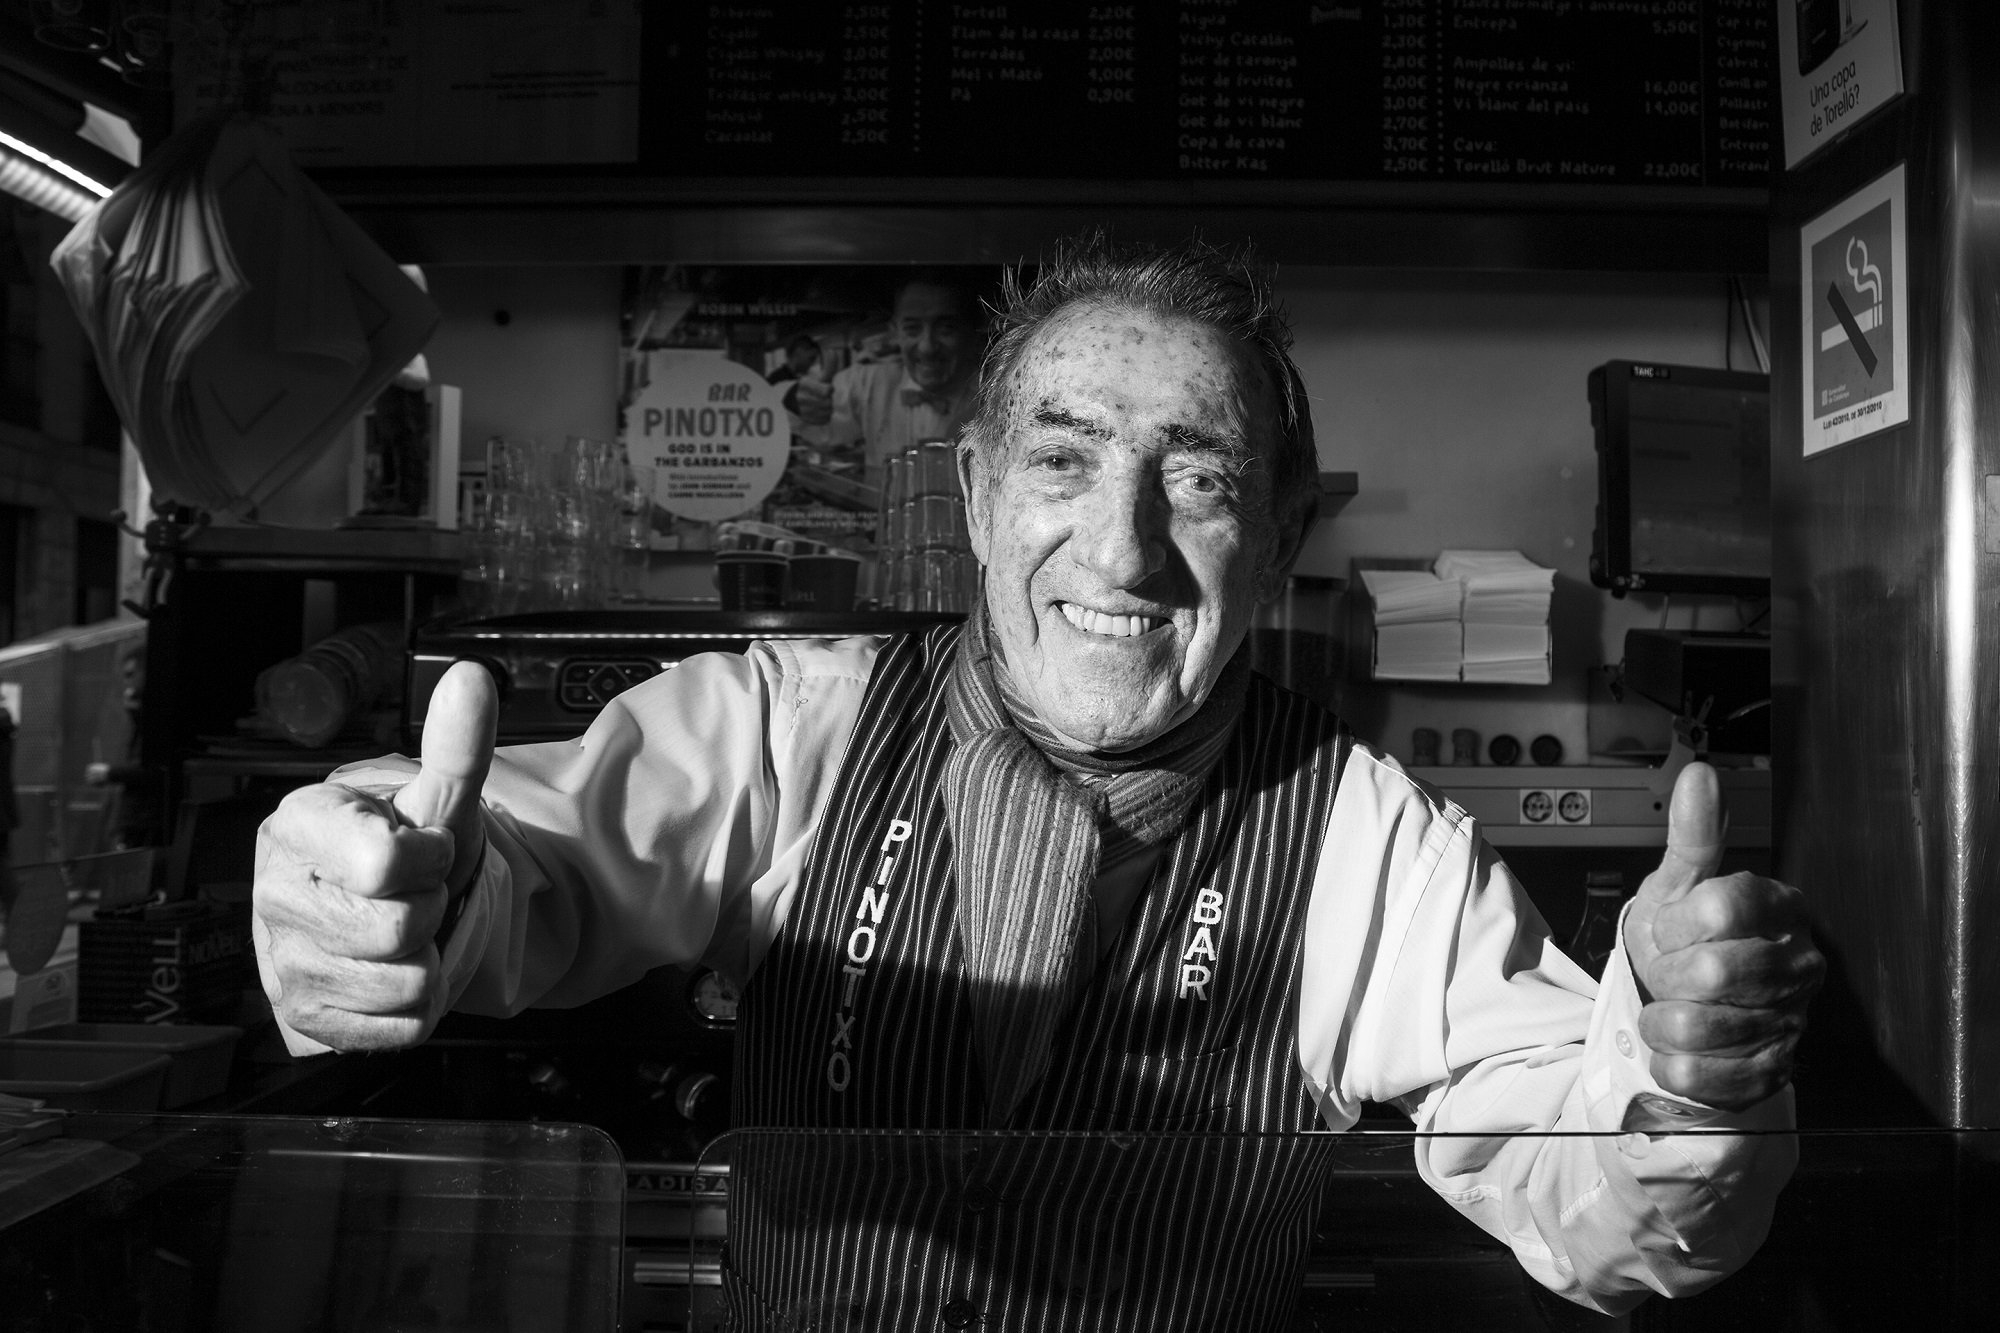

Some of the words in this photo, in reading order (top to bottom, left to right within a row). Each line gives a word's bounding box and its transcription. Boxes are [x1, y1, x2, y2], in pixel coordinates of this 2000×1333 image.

[1810, 82, 1830, 108] Una
[1831, 62, 1856, 92] copa
[1810, 113, 1823, 137] de
[1823, 83, 1860, 127] Torelló?
[698, 303, 744, 316] ROBIN
[748, 303, 797, 316] WILLIS
[707, 382, 752, 403] BAR
[643, 407, 774, 438] PINOTXO
[654, 456, 679, 468] THE
[683, 456, 764, 468] GARBANZOS
[667, 443, 697, 455] GOD
[700, 443, 713, 455] IS
[716, 443, 731, 455] IN
[826, 818, 913, 1092] PINOTXO
[1179, 887, 1224, 1001] BAR
